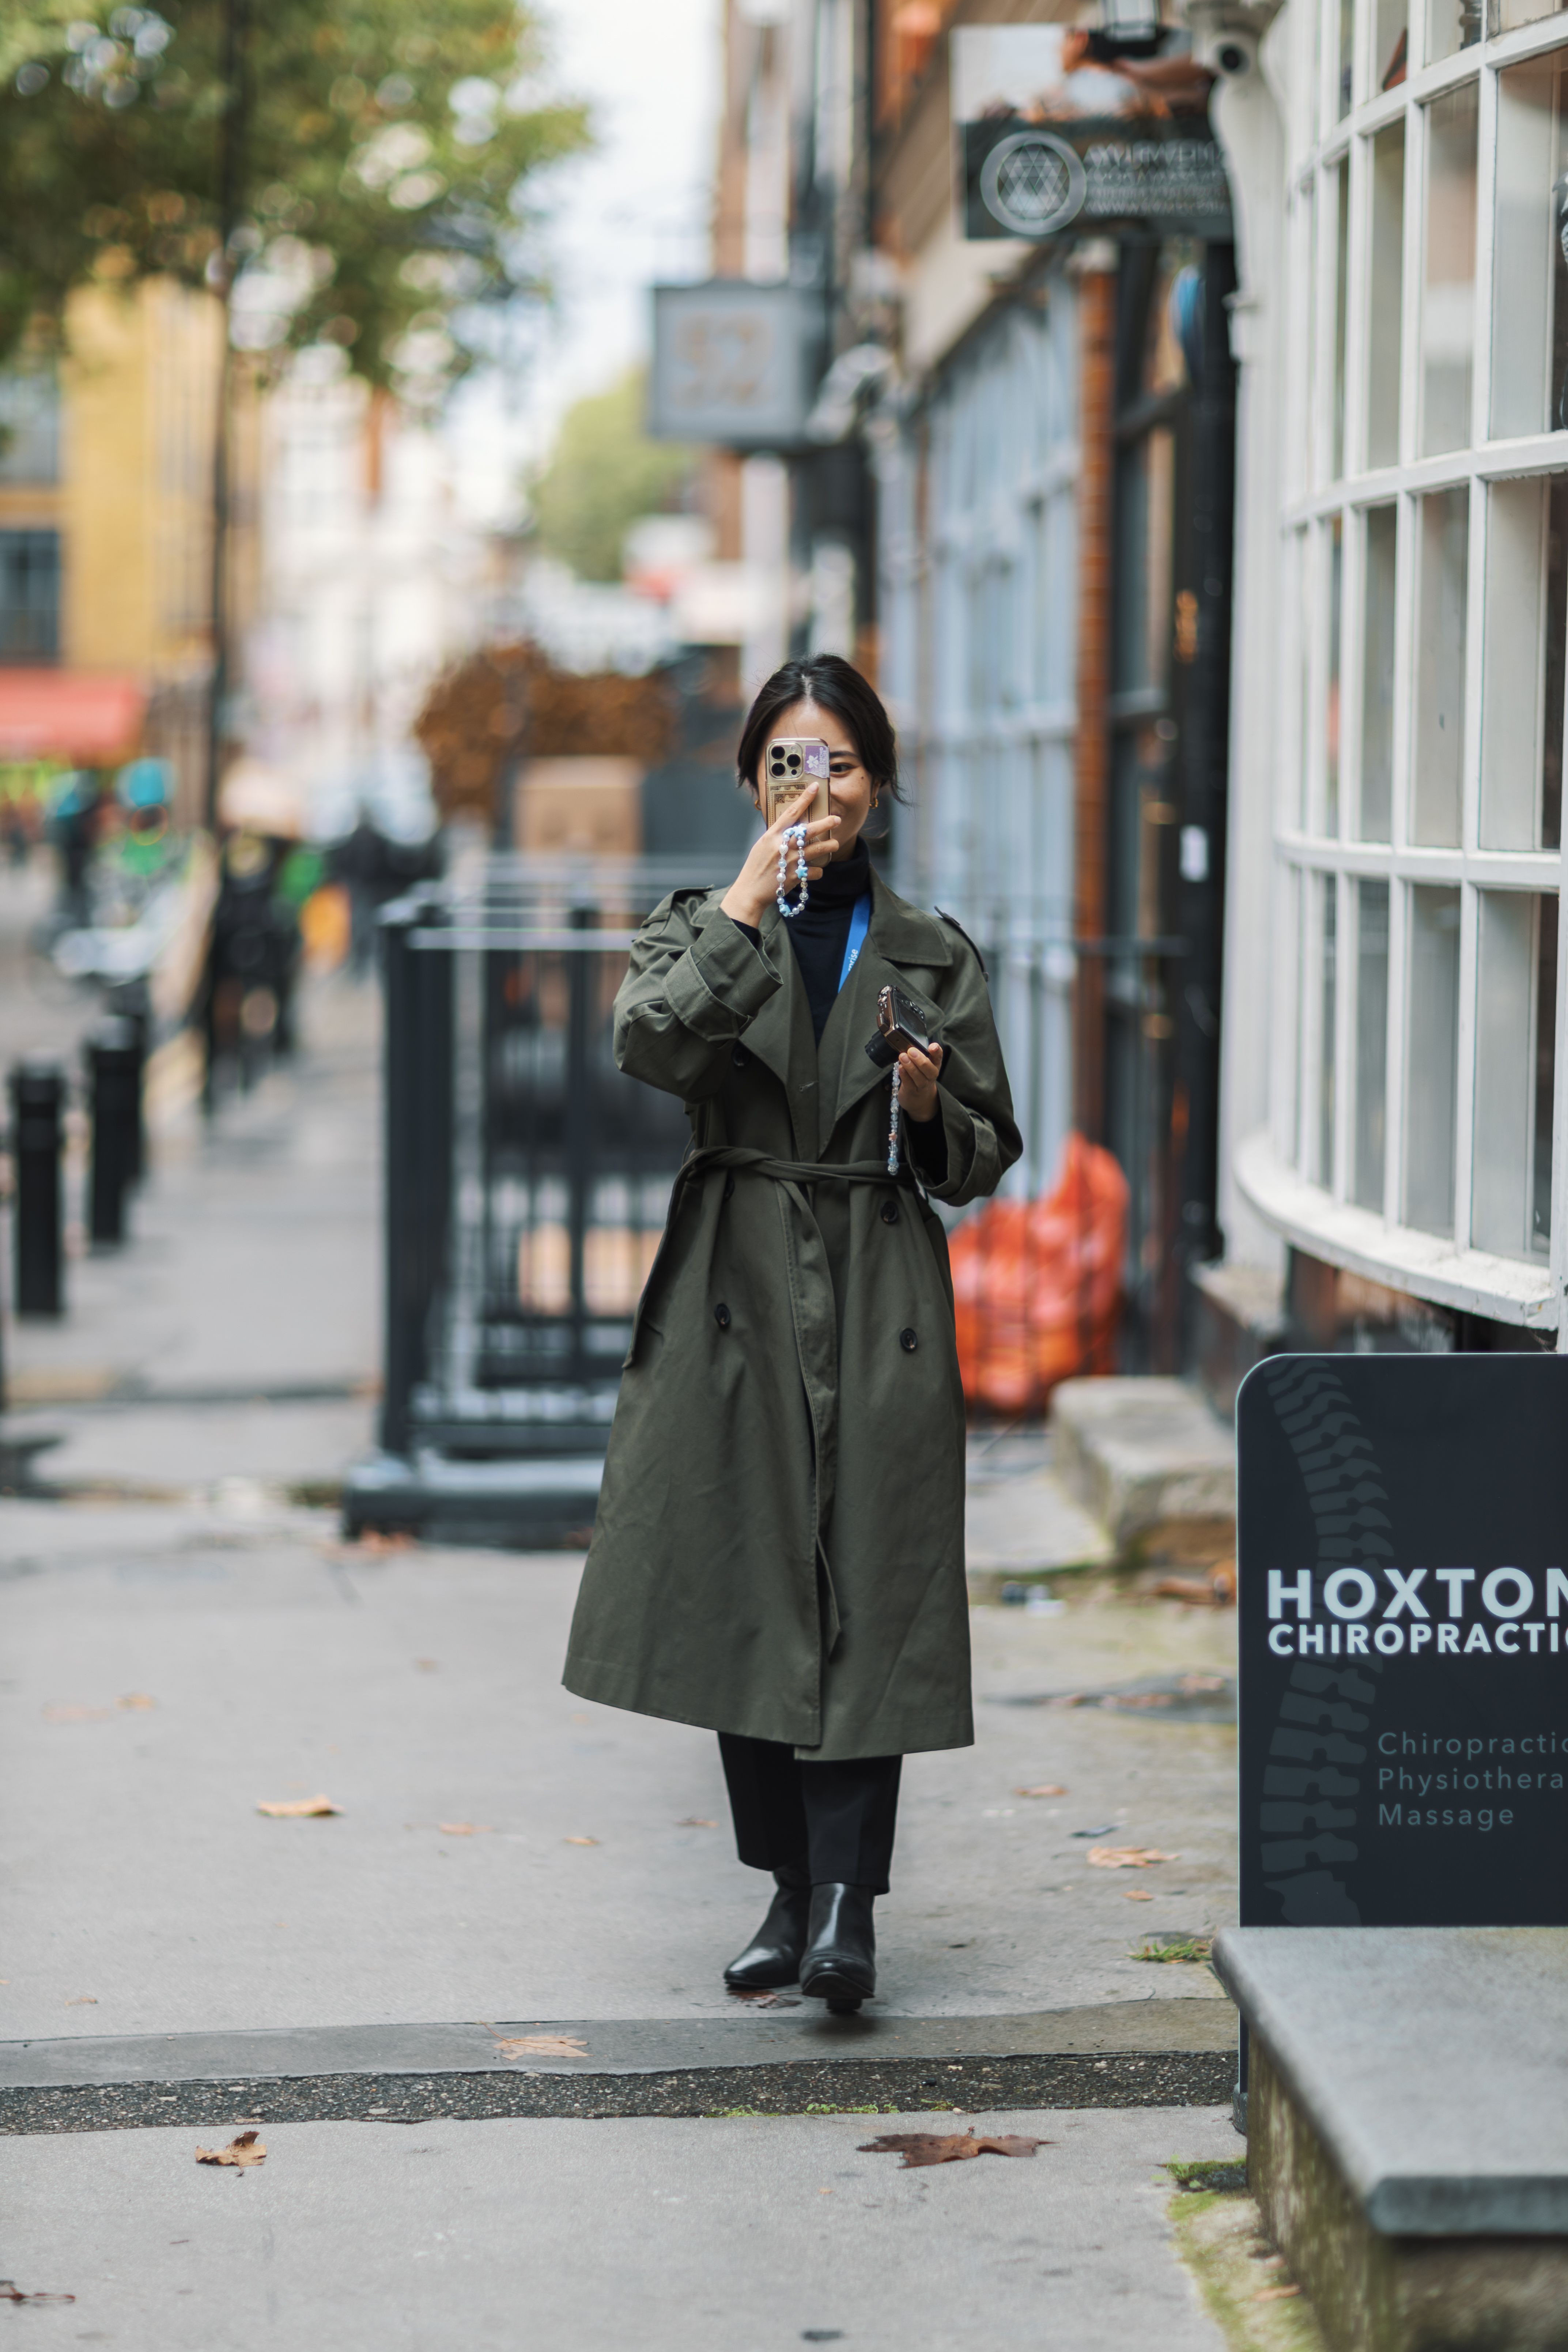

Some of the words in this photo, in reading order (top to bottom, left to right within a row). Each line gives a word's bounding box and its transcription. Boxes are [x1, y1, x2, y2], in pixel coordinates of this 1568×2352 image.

[1268, 1623, 1568, 1655] CHIROPRACTI
[1379, 1766, 1563, 1796] Physiothera
[1379, 1804, 1513, 1831] Massage
